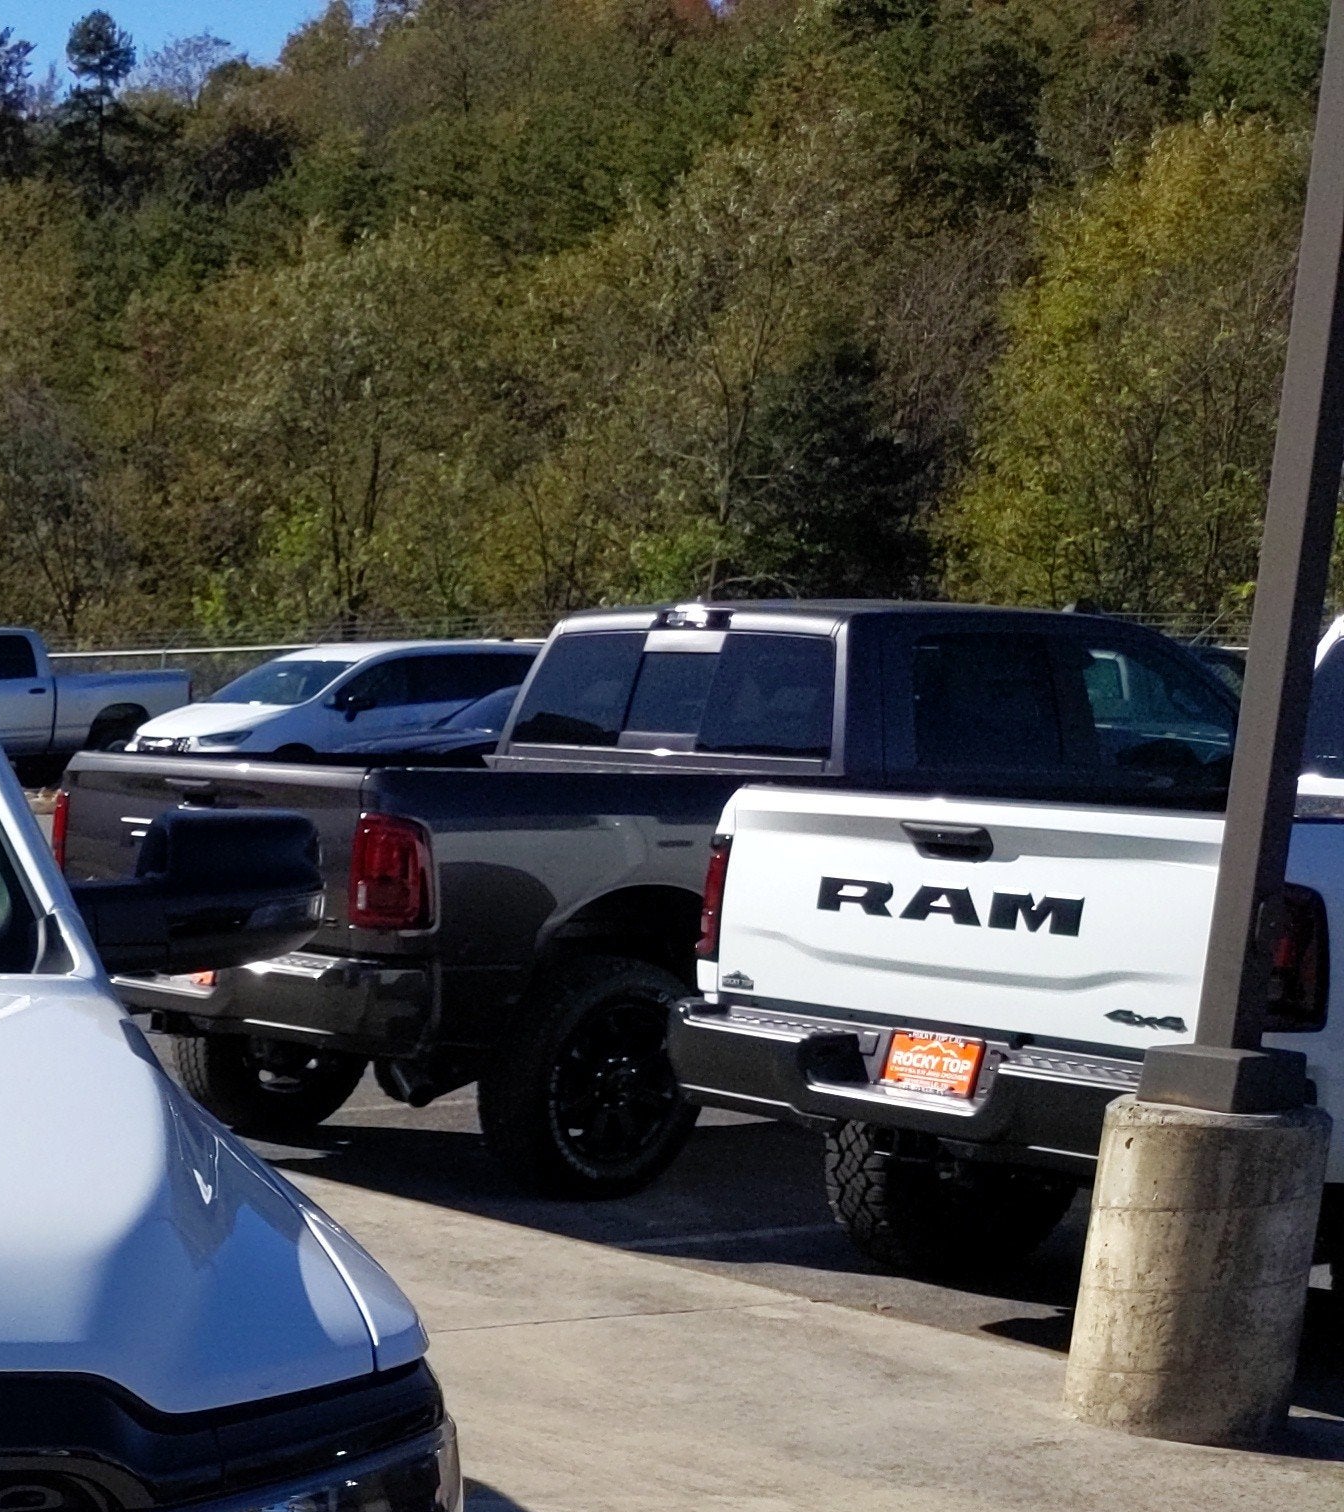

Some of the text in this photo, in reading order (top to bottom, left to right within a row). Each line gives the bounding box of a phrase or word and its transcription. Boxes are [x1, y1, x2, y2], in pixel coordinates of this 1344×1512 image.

[816, 875, 1086, 938] RAM
[892, 1051, 940, 1069] ROCKY
[941, 1056, 972, 1074] TOP
